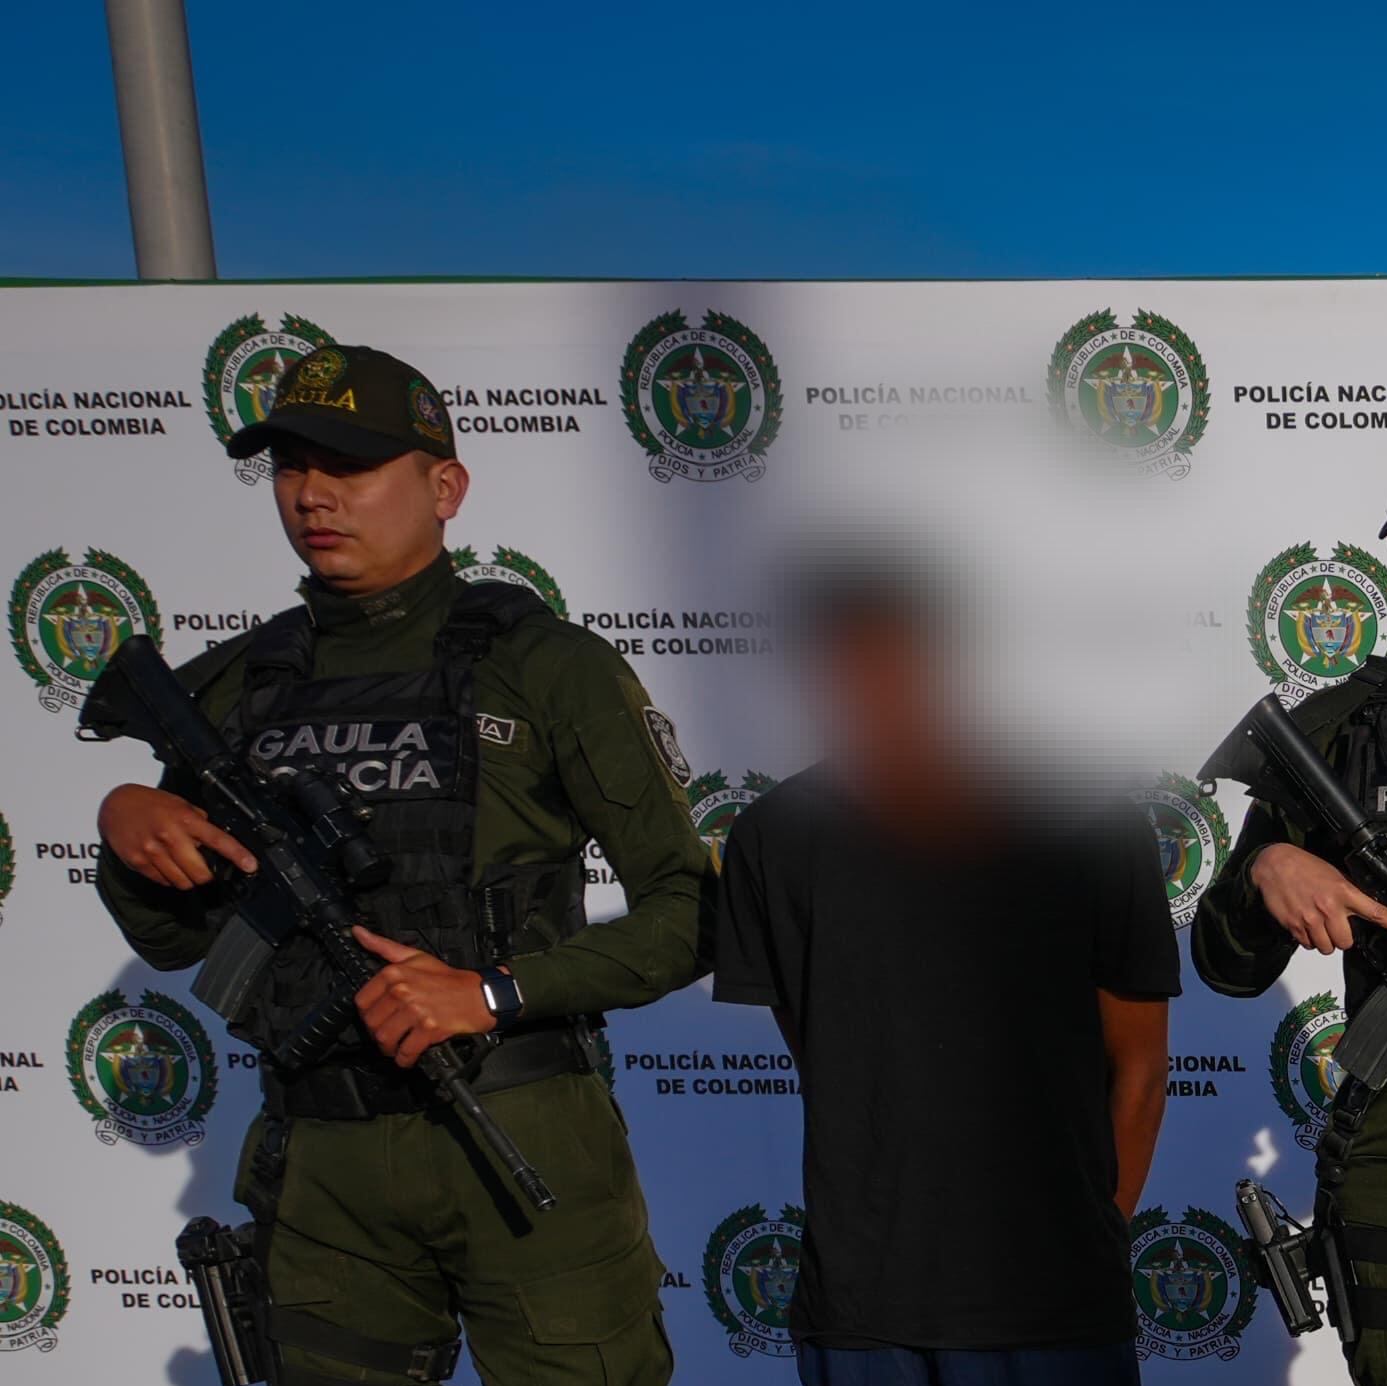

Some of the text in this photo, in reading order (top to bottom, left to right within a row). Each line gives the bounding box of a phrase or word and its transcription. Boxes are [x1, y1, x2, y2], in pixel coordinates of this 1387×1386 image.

[74, 391, 191, 408] NACIONAL
[487, 389, 607, 406] NACIONAL
[806, 382, 902, 405] POLICÍA
[1234, 382, 1329, 402] POLICÍA
[9, 418, 165, 436] DE COLOMBIA
[457, 416, 580, 433] COLOMBIA
[1267, 413, 1296, 429] DE
[583, 609, 772, 630] POLICÍA NACION
[615, 638, 645, 656] DE
[255, 722, 429, 760] GAULA
[37, 844, 103, 860] POLIC
[625, 1051, 793, 1070] POLICÍA NACIO
[657, 1079, 685, 1094] DE
[91, 1270, 178, 1284] POLICÍA
[122, 1294, 150, 1308] DE
